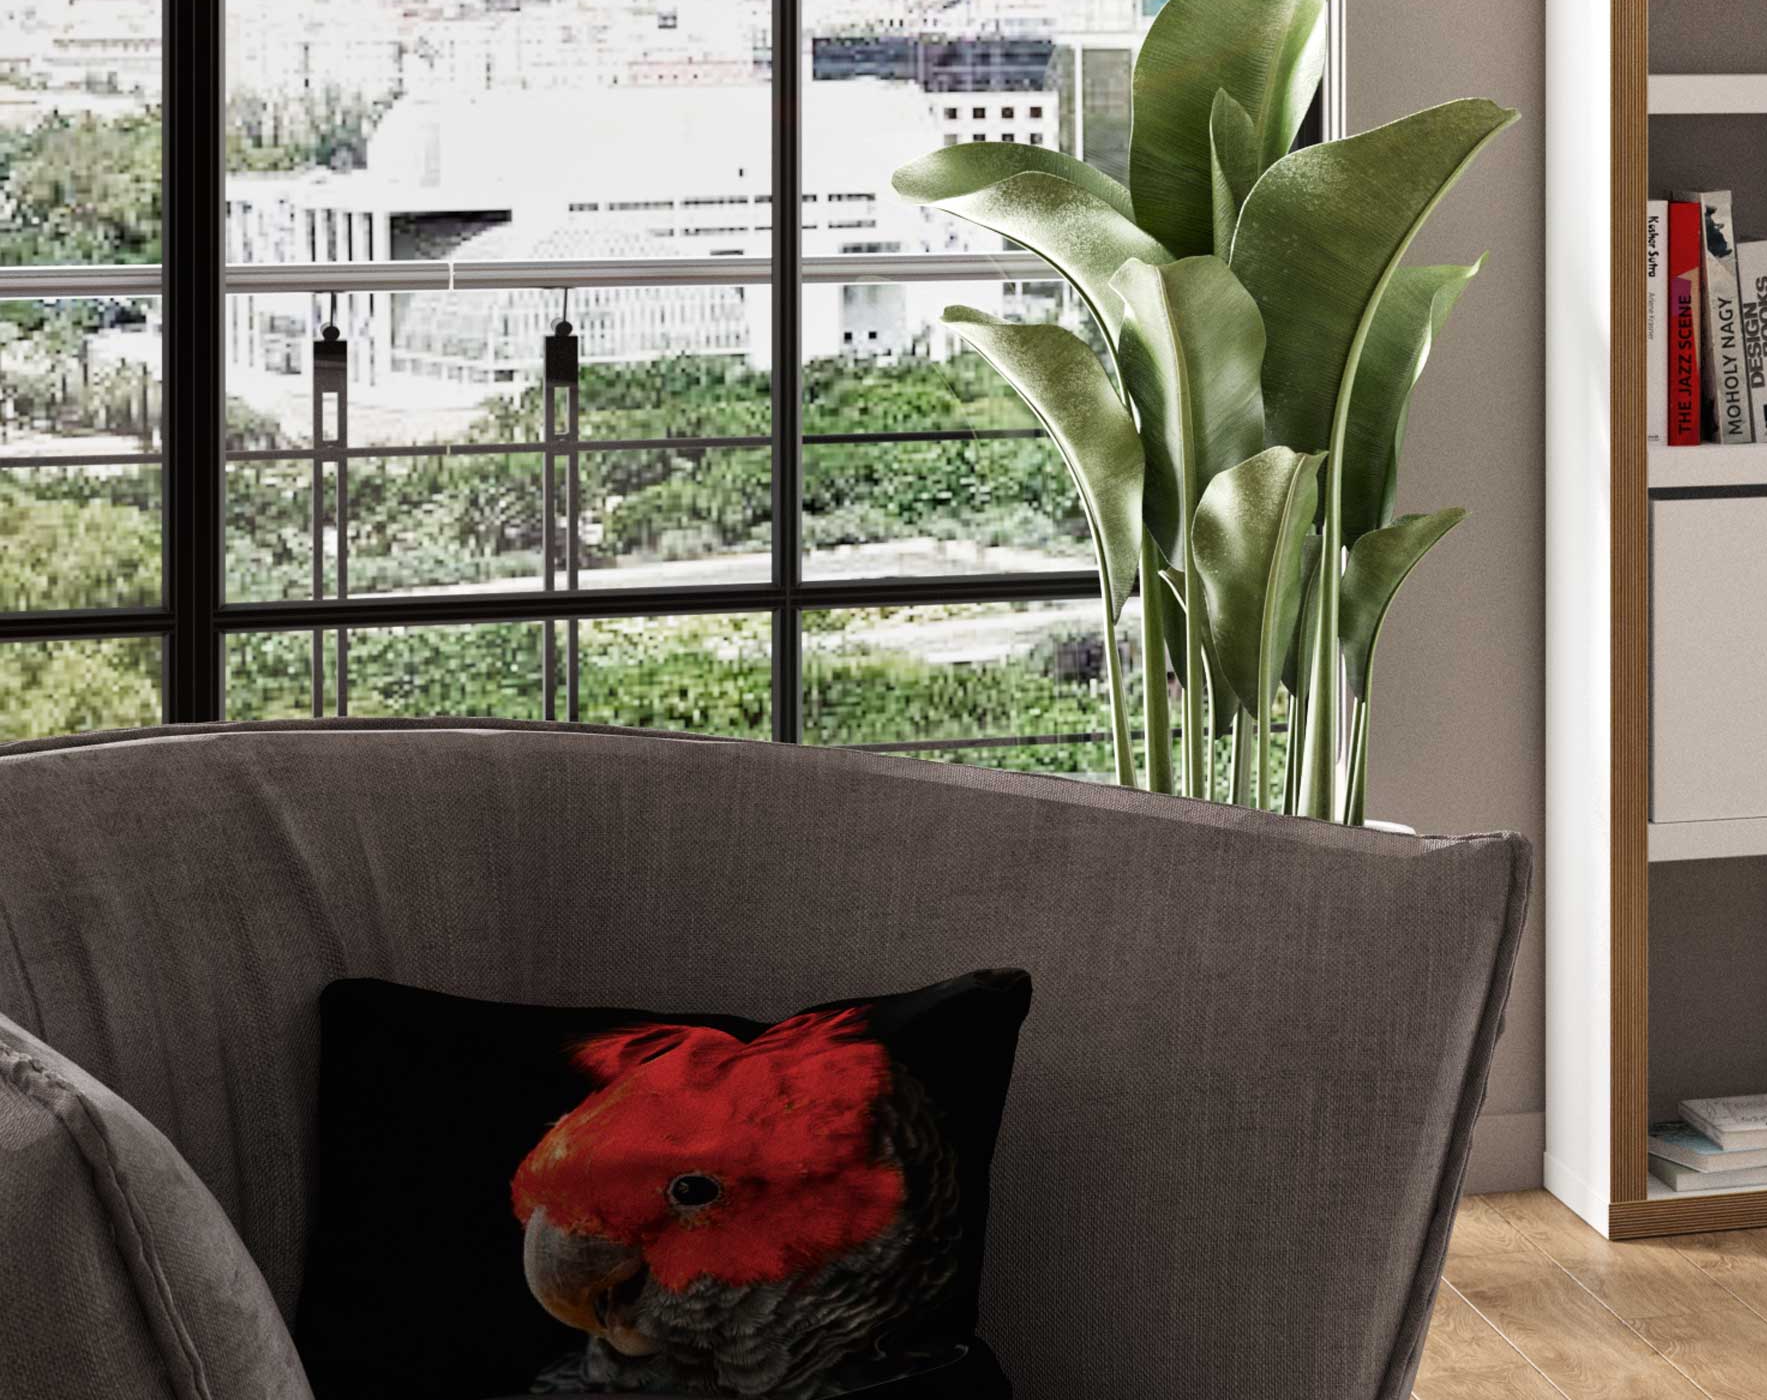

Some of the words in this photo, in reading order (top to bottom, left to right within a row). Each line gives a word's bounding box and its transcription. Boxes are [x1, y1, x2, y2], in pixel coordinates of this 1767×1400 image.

[1677, 295, 1691, 350] SCENE
[1718, 297, 1735, 348] NAGY
[1743, 302, 1765, 389] DESIGN
[1677, 354, 1691, 397] JAZZ
[1723, 355, 1743, 435] MOHOLY
[1677, 401, 1691, 435] THE
